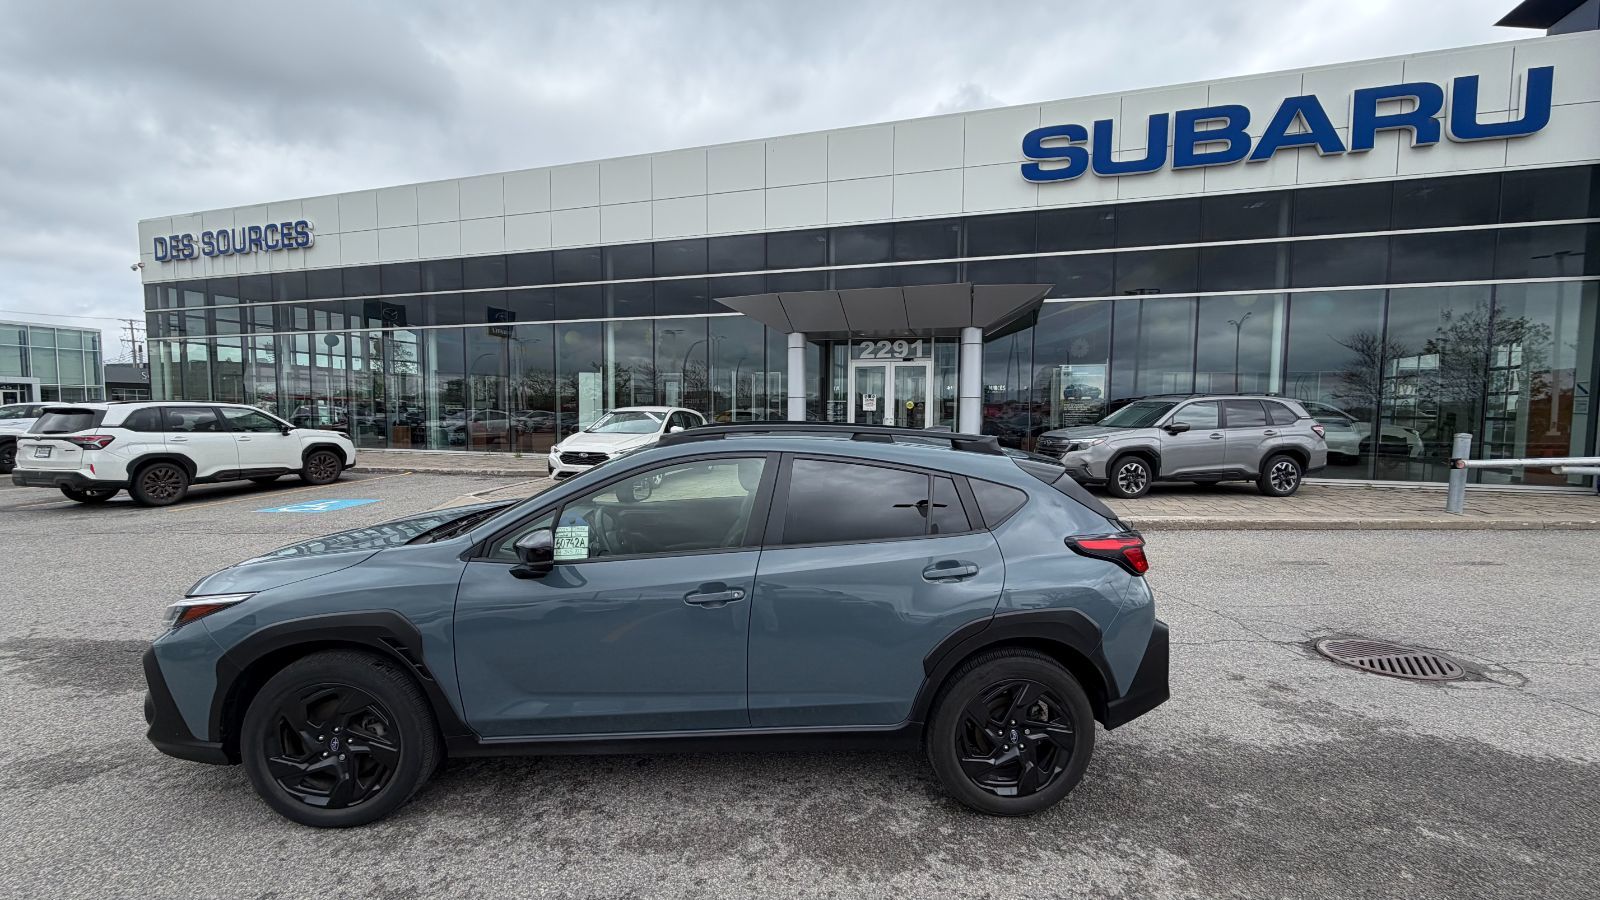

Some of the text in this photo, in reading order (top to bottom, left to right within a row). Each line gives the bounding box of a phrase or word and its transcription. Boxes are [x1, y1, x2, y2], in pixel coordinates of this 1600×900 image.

[1021, 66, 1554, 182] SUBARU
[153, 220, 313, 261] DES SOURCES
[860, 340, 923, 359] 2291
